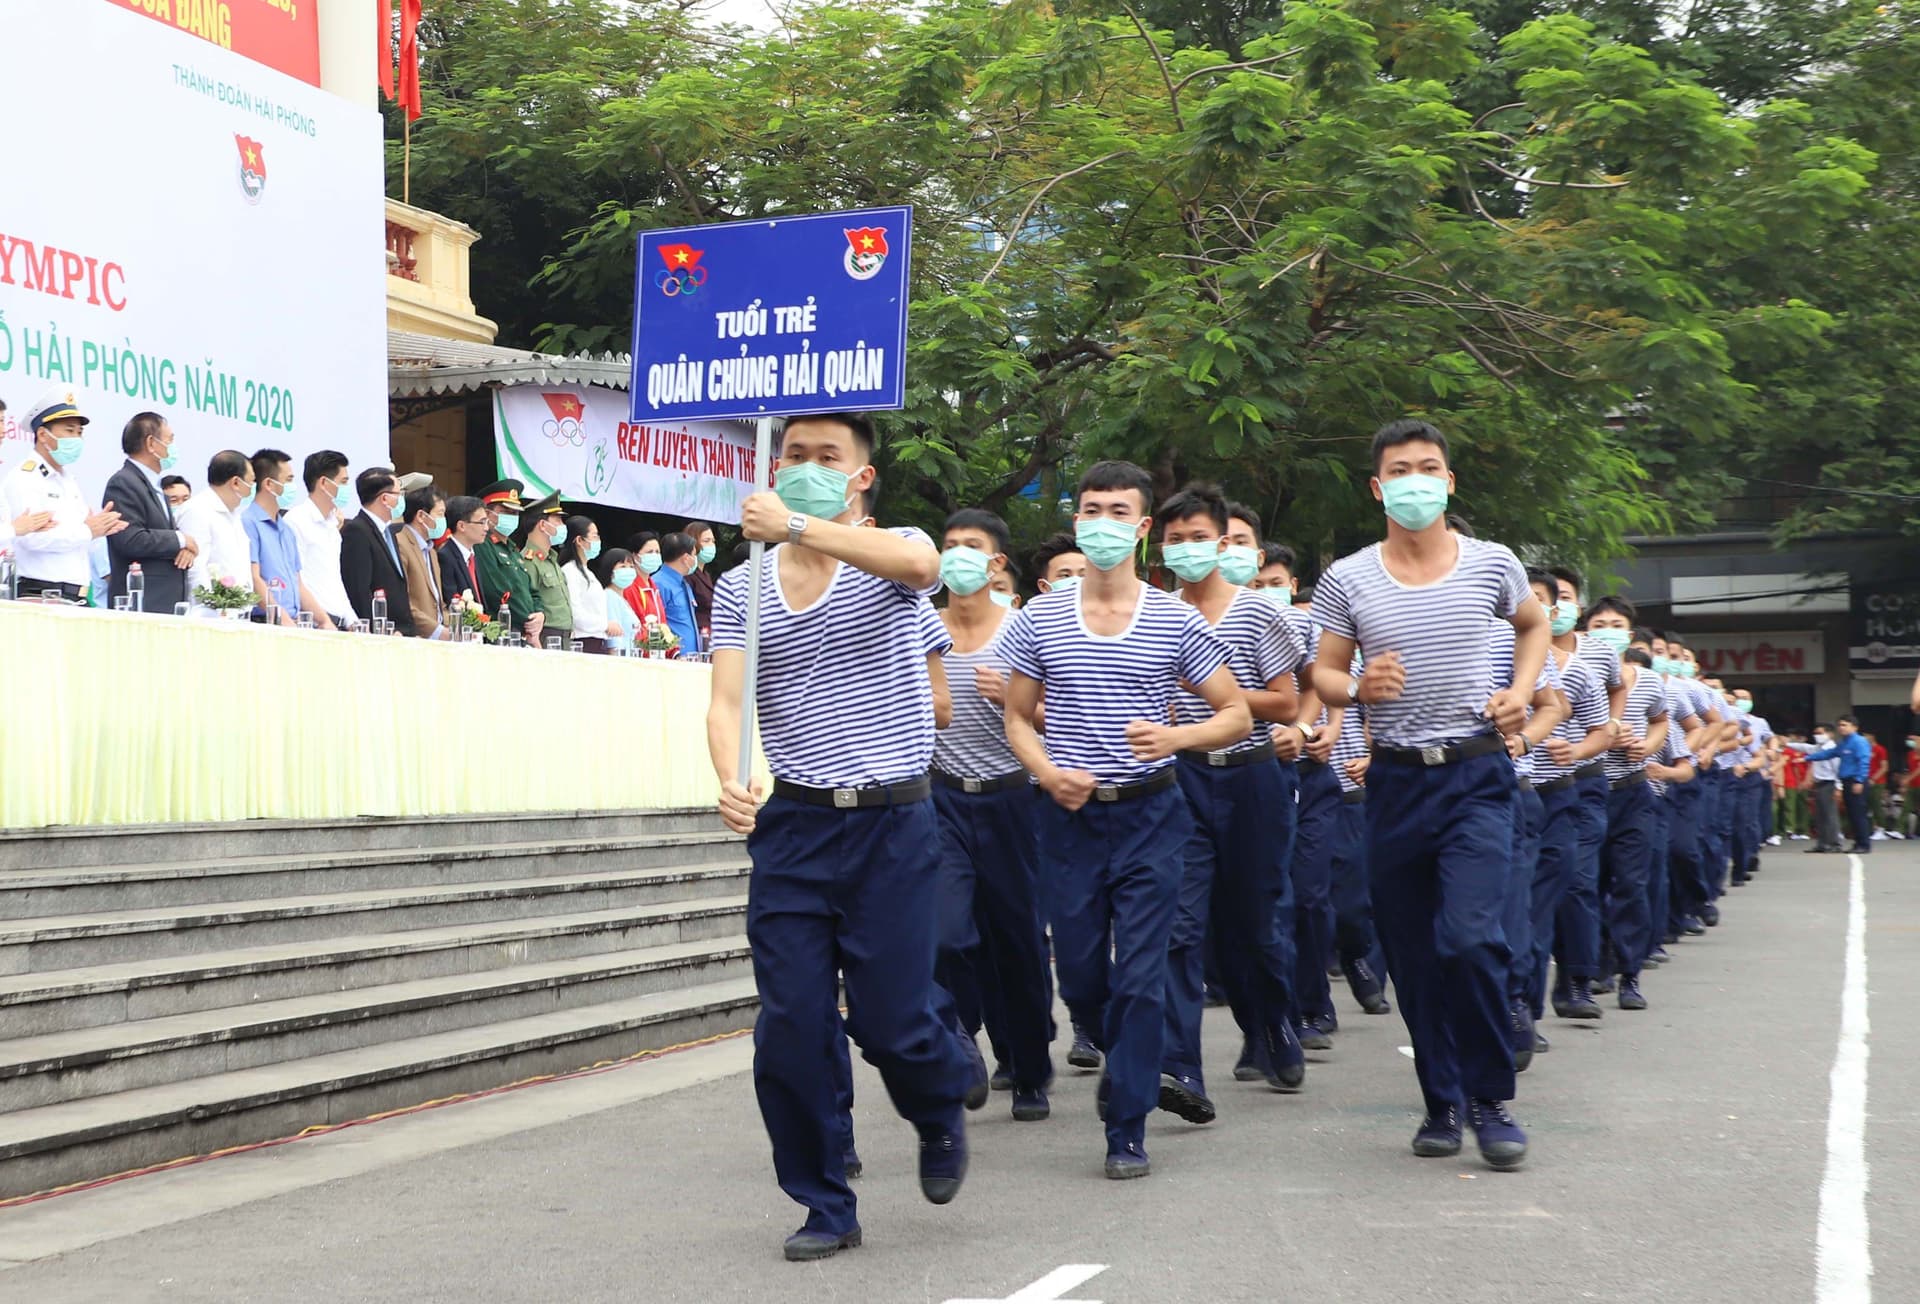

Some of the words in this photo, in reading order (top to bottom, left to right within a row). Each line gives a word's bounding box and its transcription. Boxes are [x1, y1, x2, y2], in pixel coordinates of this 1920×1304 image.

[172, 63, 215, 98] THÀNH
[218, 81, 252, 113] ĐOÀN
[255, 95, 274, 121] HẢI
[277, 105, 316, 138] PHÒNG
[716, 298, 767, 339] TUỔI
[774, 295, 817, 334] TRẺ
[24, 321, 74, 384] HẢI
[82, 337, 178, 407] PHÒNG
[185, 356, 239, 418] NĂM
[245, 379, 294, 432] 2020
[648, 353, 704, 410] QUÂN
[708, 343, 778, 401] CHỦNG
[783, 338, 819, 396] HẢI
[824, 340, 884, 398] QUÂN
[653, 425, 700, 479] LUYỆN
[701, 433, 735, 480] THÂN
